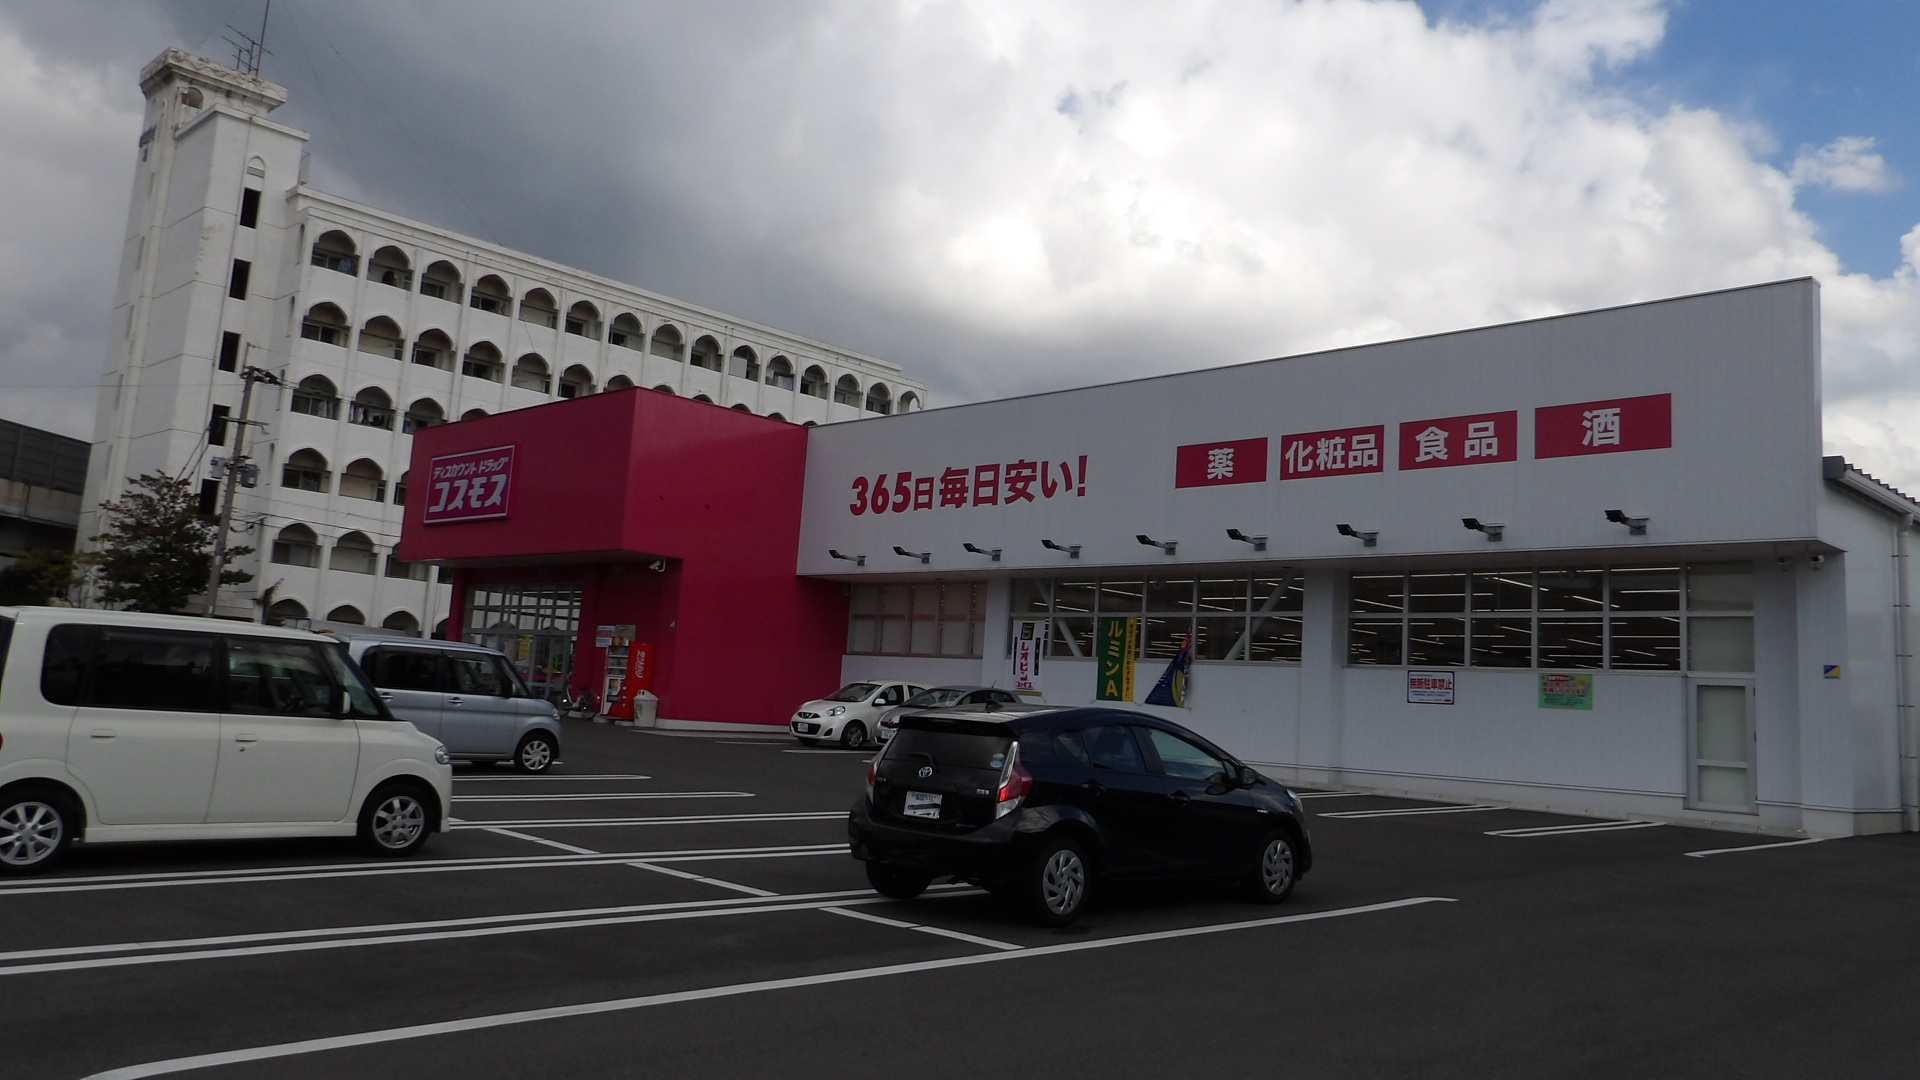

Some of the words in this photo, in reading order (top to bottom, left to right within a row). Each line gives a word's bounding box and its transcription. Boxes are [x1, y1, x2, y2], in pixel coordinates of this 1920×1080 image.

[1414, 421, 1498, 463] 食品
[1581, 407, 1621, 448] 酒
[433, 461, 477, 480] ディスカウント
[478, 456, 510, 475] ドラッグ
[1206, 448, 1234, 480] 薬
[1284, 434, 1379, 473] 化粧品
[428, 473, 507, 513] コスモス
[849, 454, 1088, 516] 365日毎日安い!
[1105, 620, 1124, 697] ルミンA
